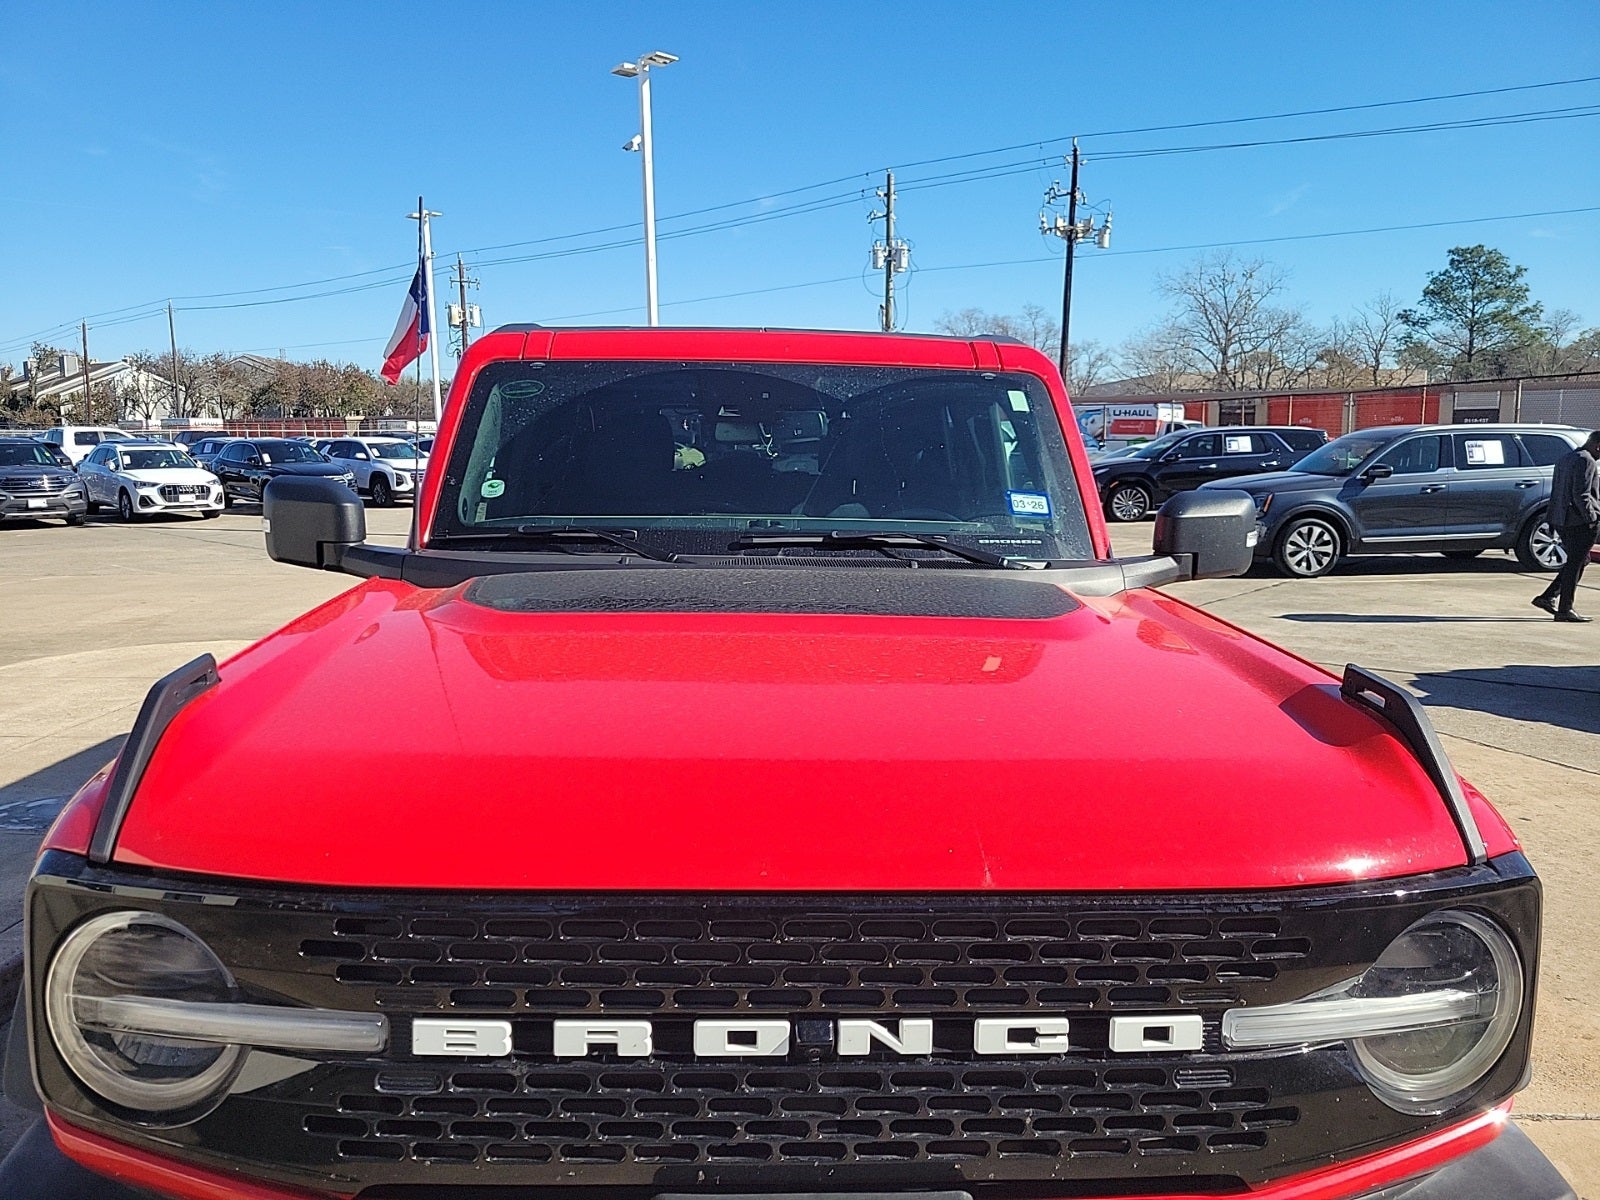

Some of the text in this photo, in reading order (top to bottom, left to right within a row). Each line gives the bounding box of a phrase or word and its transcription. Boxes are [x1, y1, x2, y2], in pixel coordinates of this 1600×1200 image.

[1112, 409, 1153, 417] U-HAUL
[1012, 499, 1026, 509] 03
[411, 1015, 1204, 1057] BRONCO
